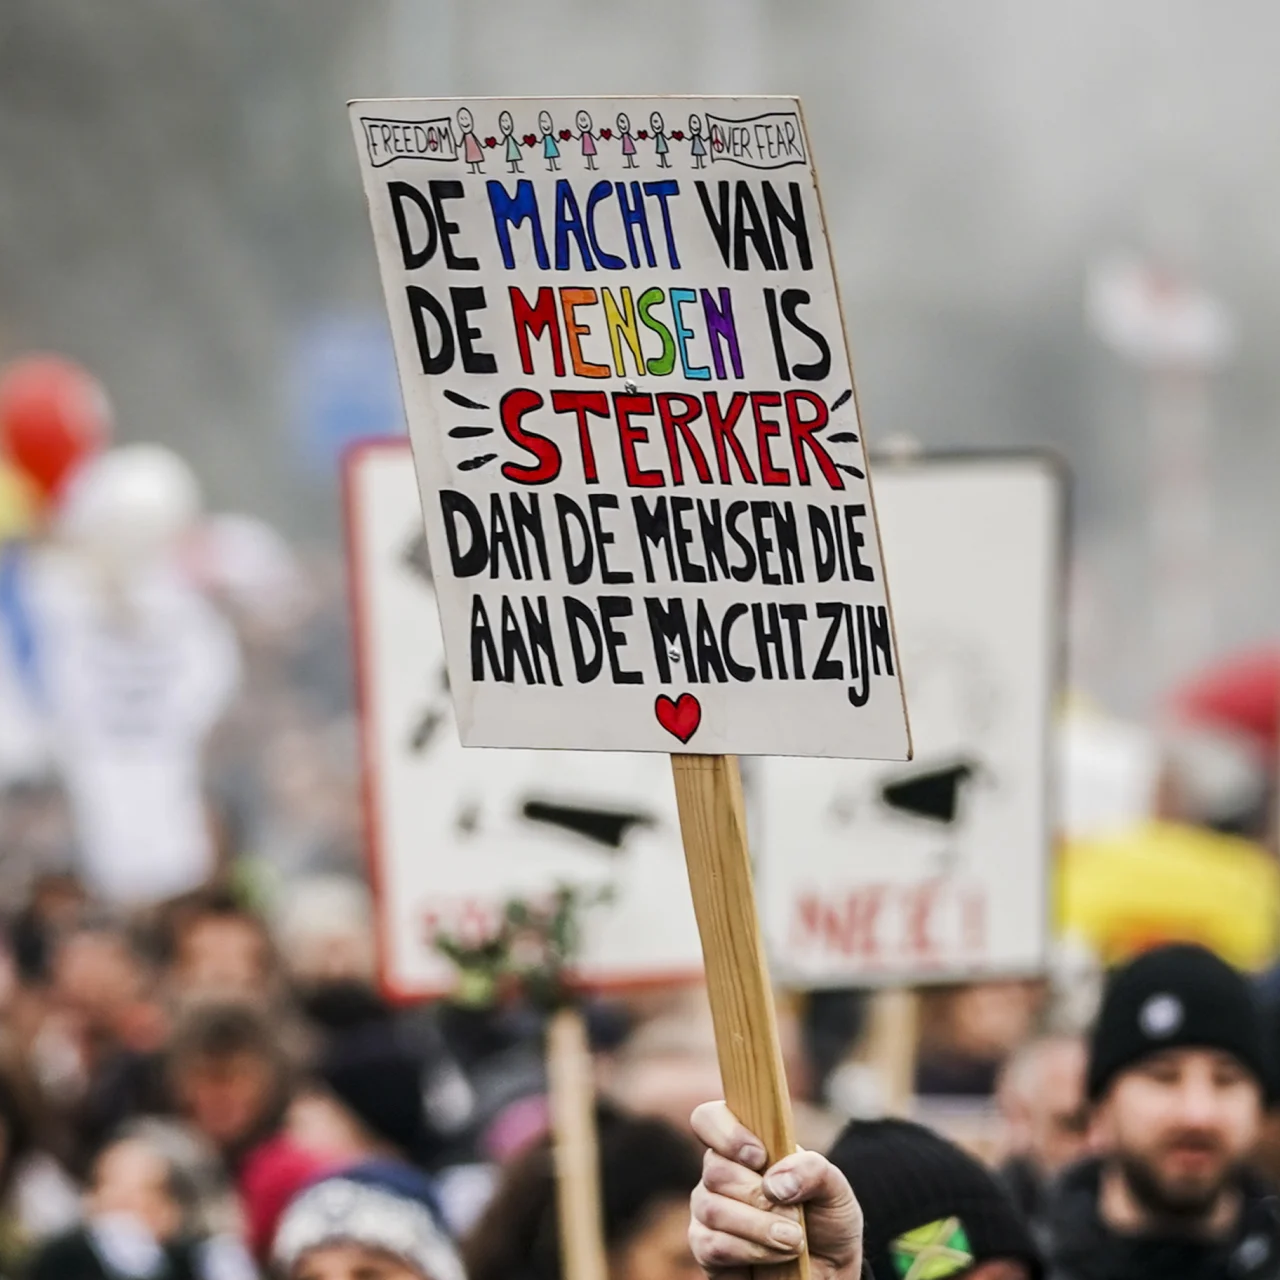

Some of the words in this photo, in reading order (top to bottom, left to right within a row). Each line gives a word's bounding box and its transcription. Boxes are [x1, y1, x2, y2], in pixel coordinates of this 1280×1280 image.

[368, 123, 455, 157] FREEDOM
[711, 123, 753, 159] OVER
[754, 121, 803, 160] FEAR
[387, 180, 480, 271] DE
[486, 179, 681, 271] MACHT
[695, 179, 814, 271] VAN
[406, 285, 498, 375] DE
[508, 285, 745, 380] MENSEN
[765, 287, 832, 382] IS
[500, 389, 845, 490] STERKER
[439, 489, 552, 581] DAN
[555, 493, 634, 585] DE
[631, 495, 806, 585] MENSEN
[808, 503, 876, 583] DIE
[471, 594, 564, 687] AAN
[563, 595, 644, 685] DE
[643, 597, 808, 685] MACHT
[812, 601, 895, 707] ZIJN
